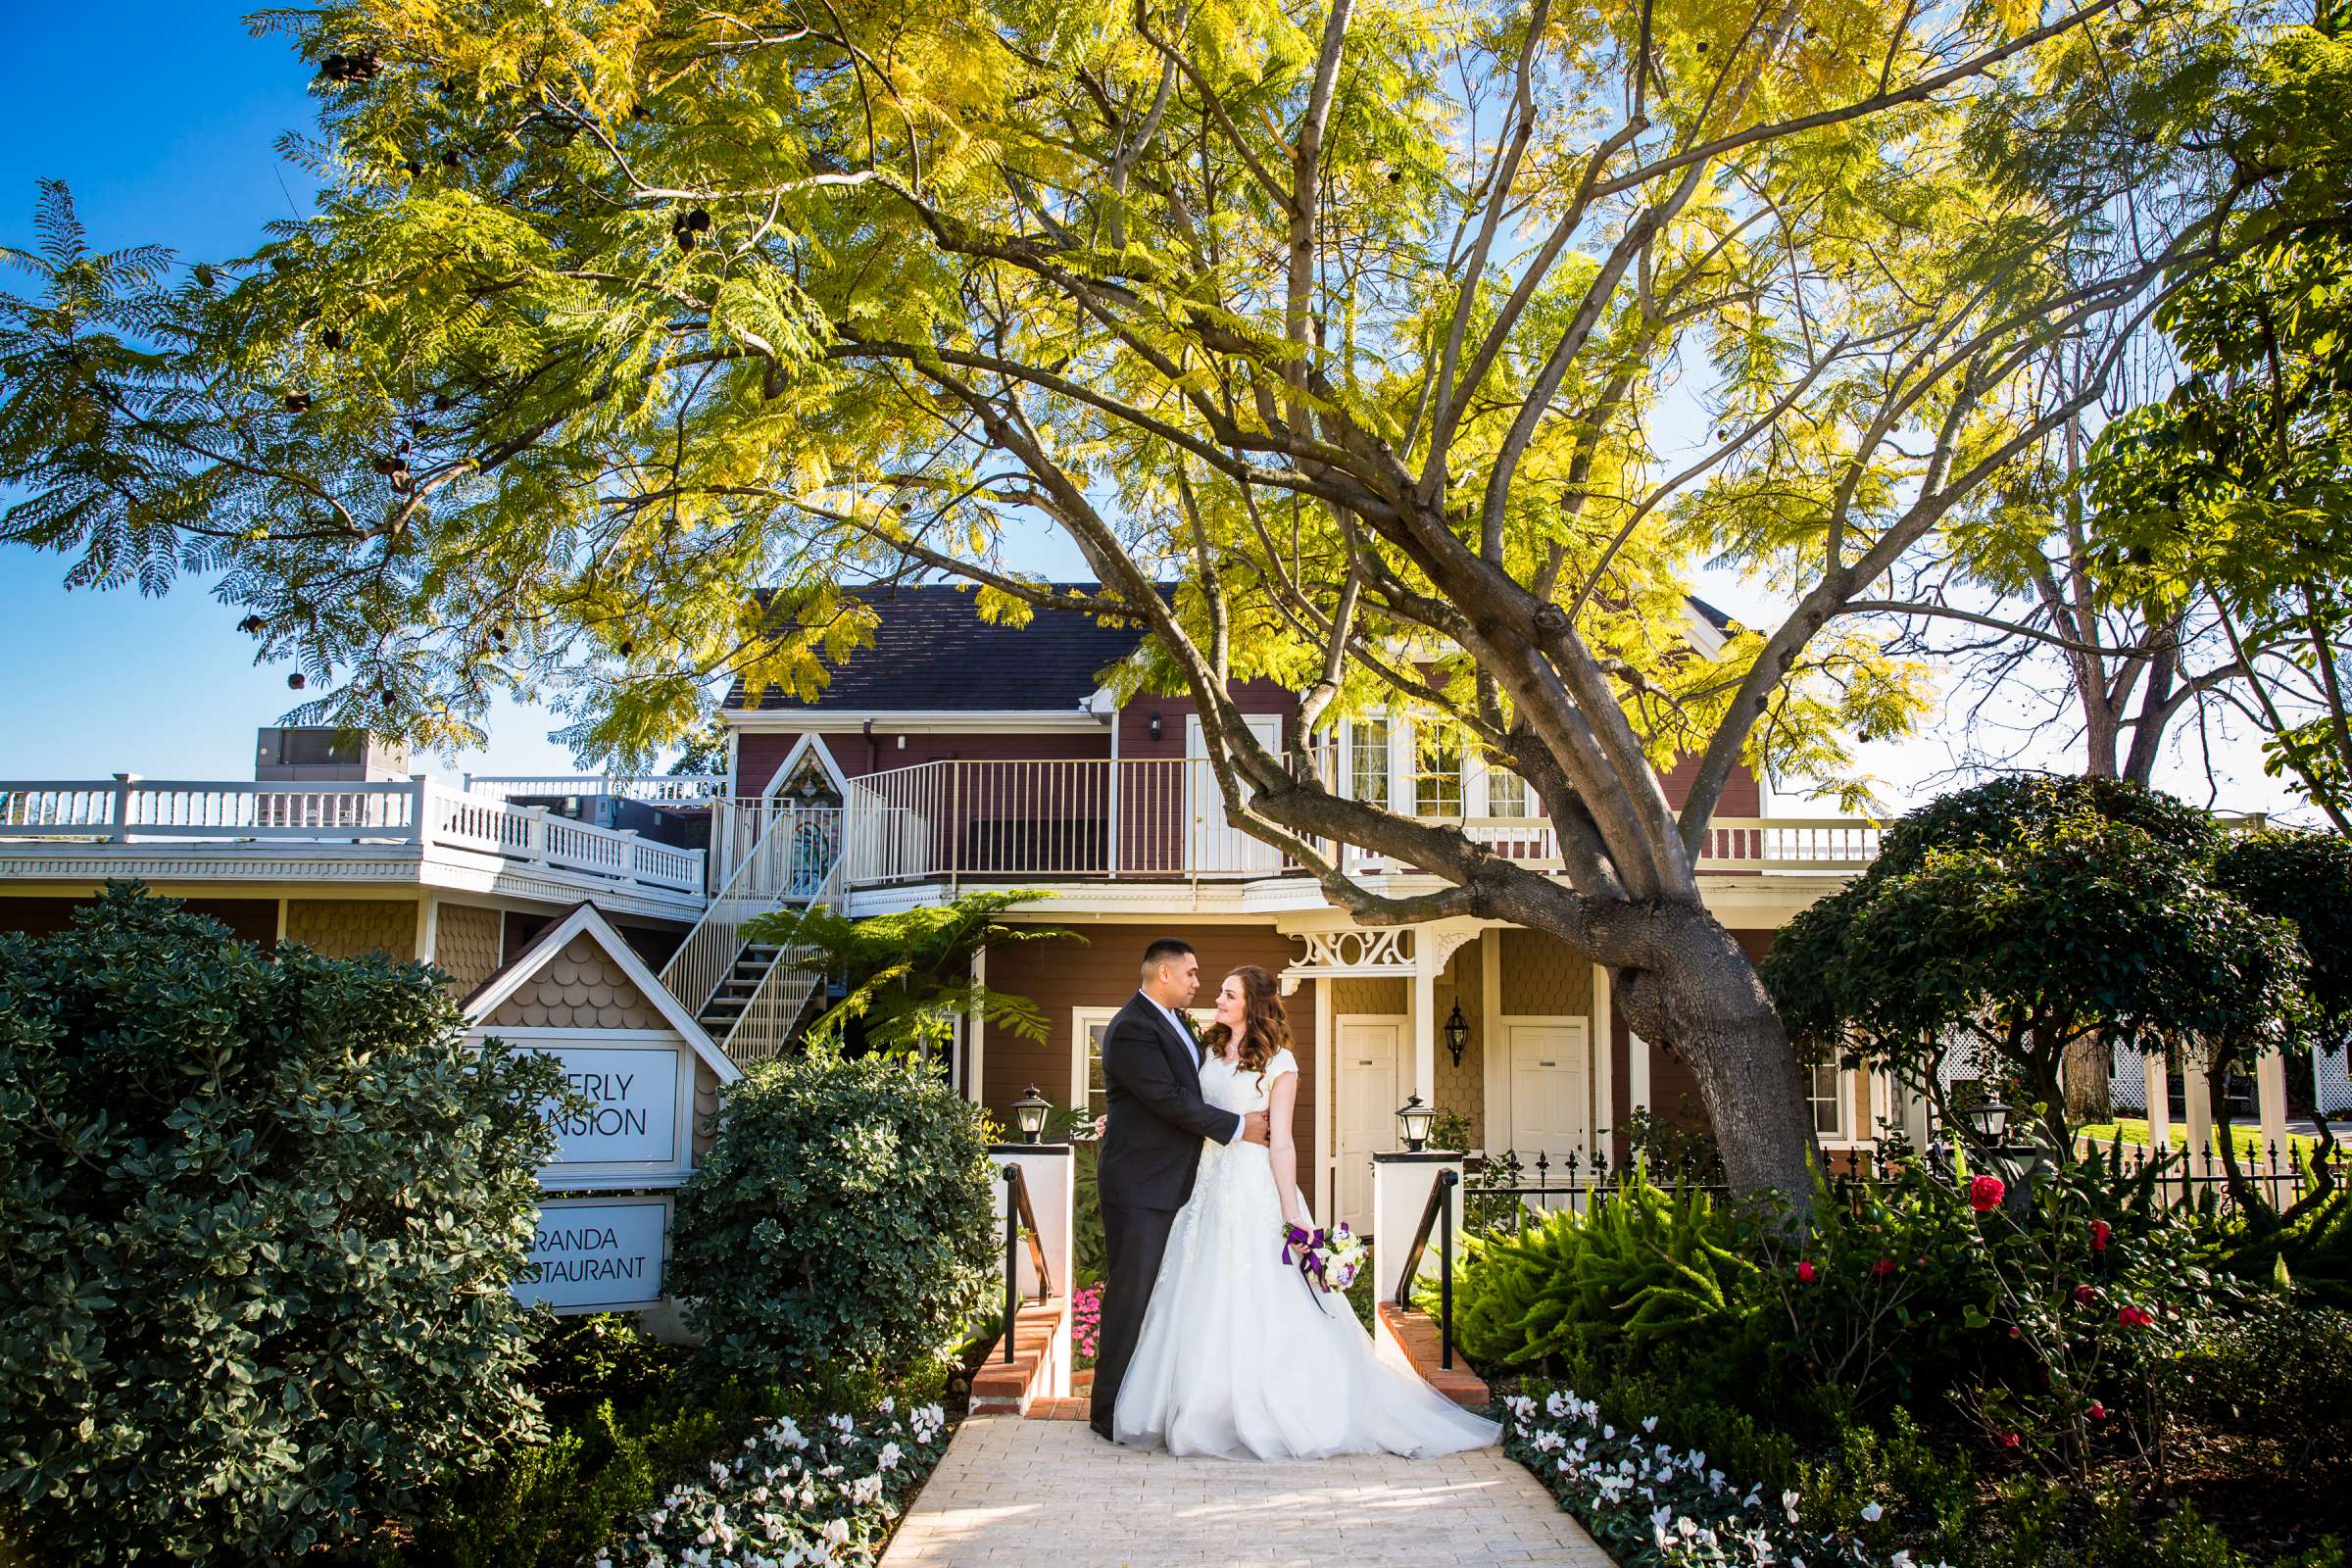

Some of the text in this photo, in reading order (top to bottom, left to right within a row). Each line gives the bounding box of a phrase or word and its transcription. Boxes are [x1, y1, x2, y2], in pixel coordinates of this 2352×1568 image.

[551, 1073, 634, 1102] ERLY
[543, 1107, 647, 1137] NSION
[532, 1227, 618, 1252] RANDA
[514, 1256, 646, 1285] STAURANT
